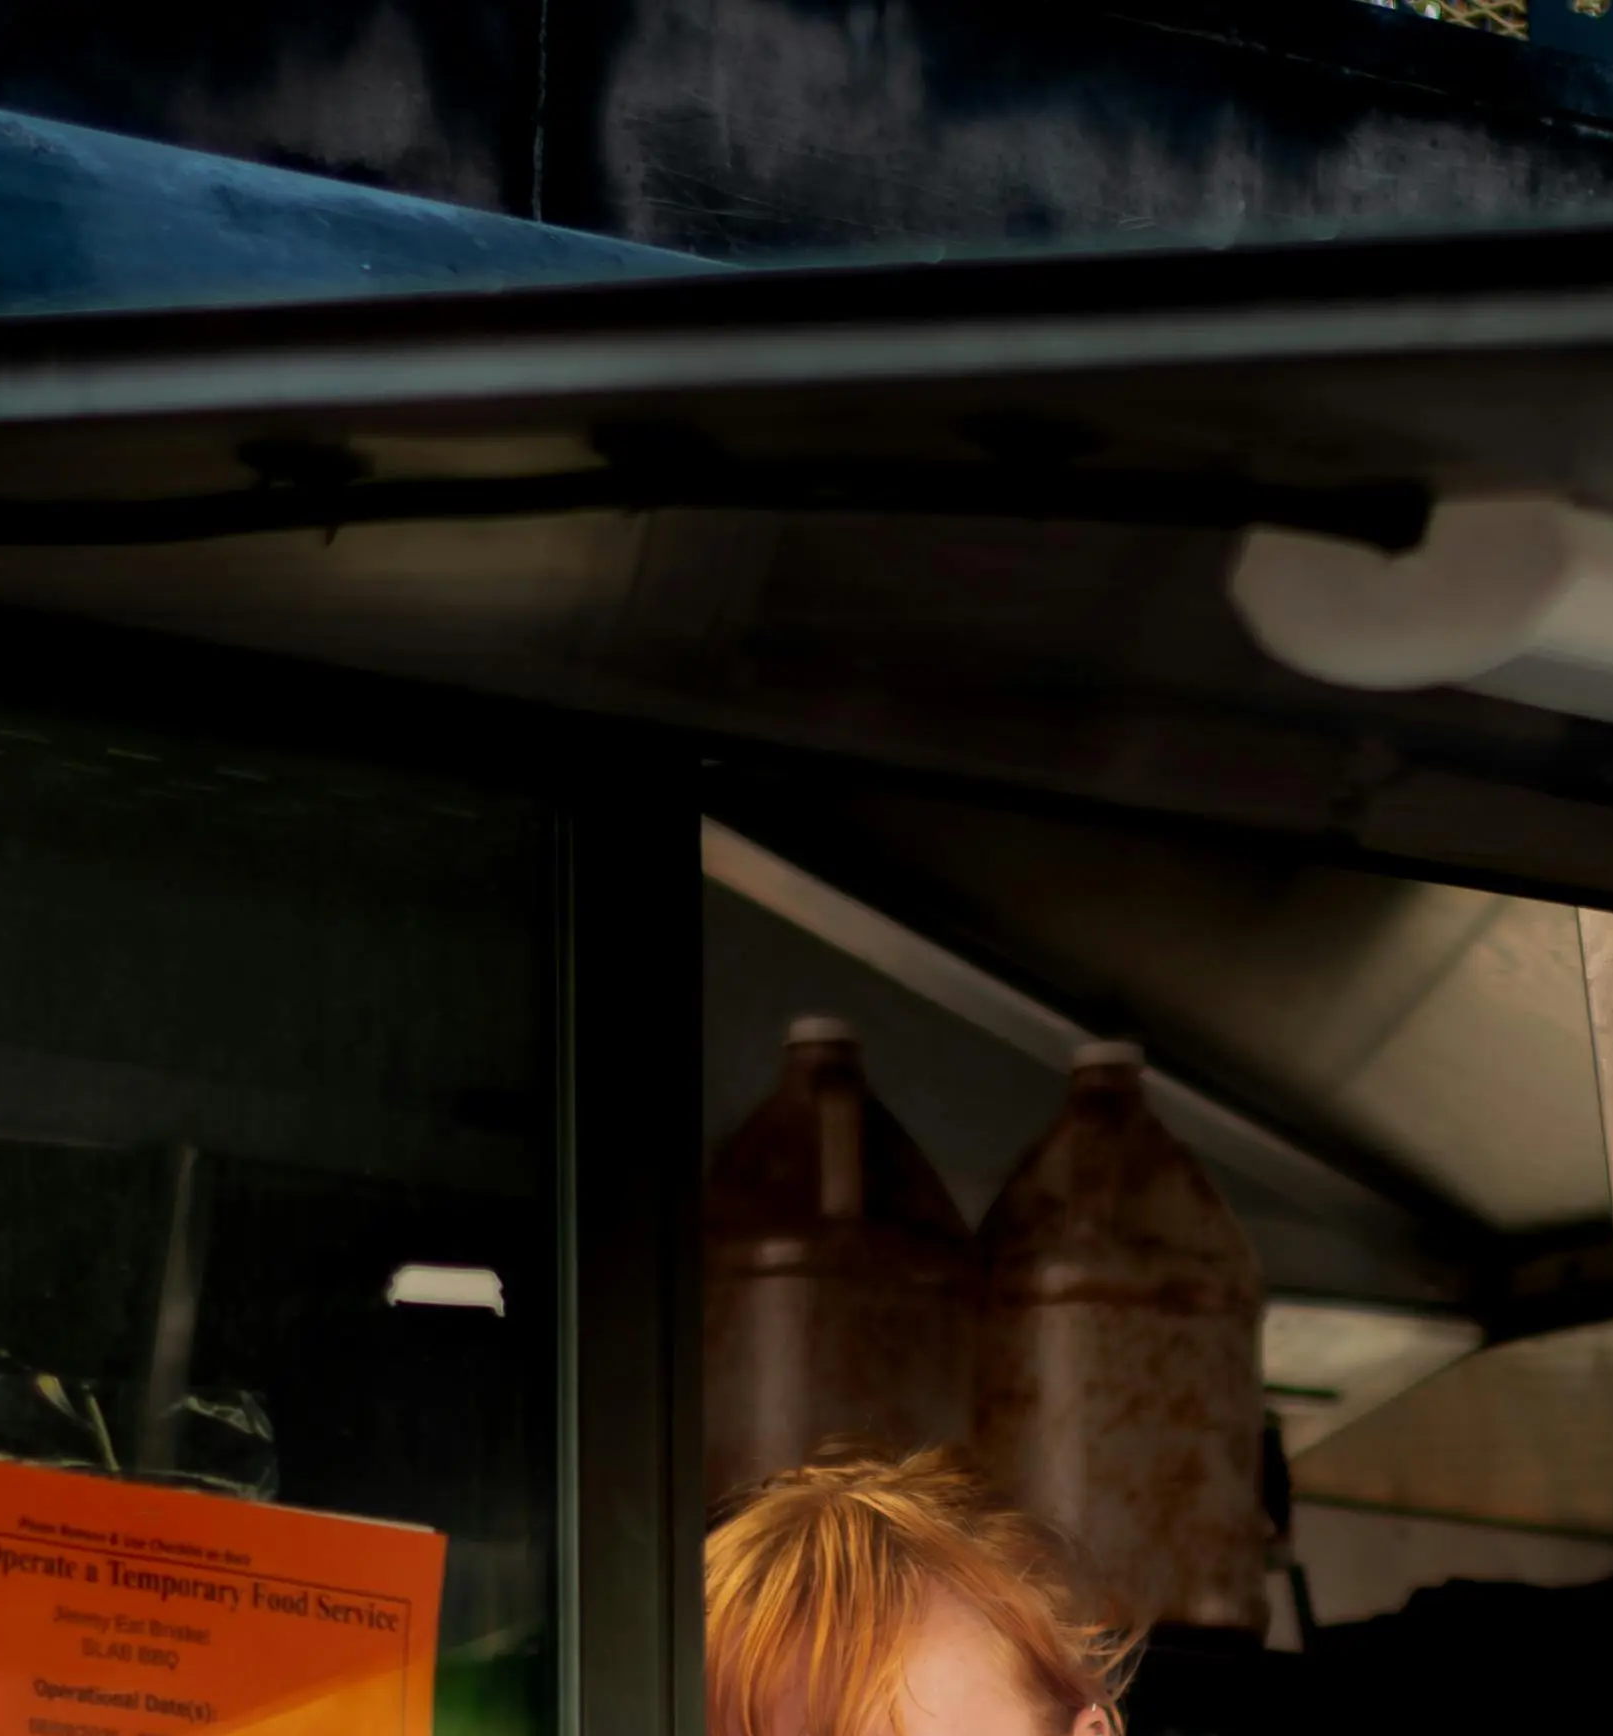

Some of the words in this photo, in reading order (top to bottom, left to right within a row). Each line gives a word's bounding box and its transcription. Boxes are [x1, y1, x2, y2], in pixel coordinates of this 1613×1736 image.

[84, 1563, 99, 1583] a
[106, 1558, 242, 1612] Temporary
[251, 1581, 309, 1618] Food
[317, 1594, 400, 1632] Service
[32, 1677, 139, 1710] Operational
